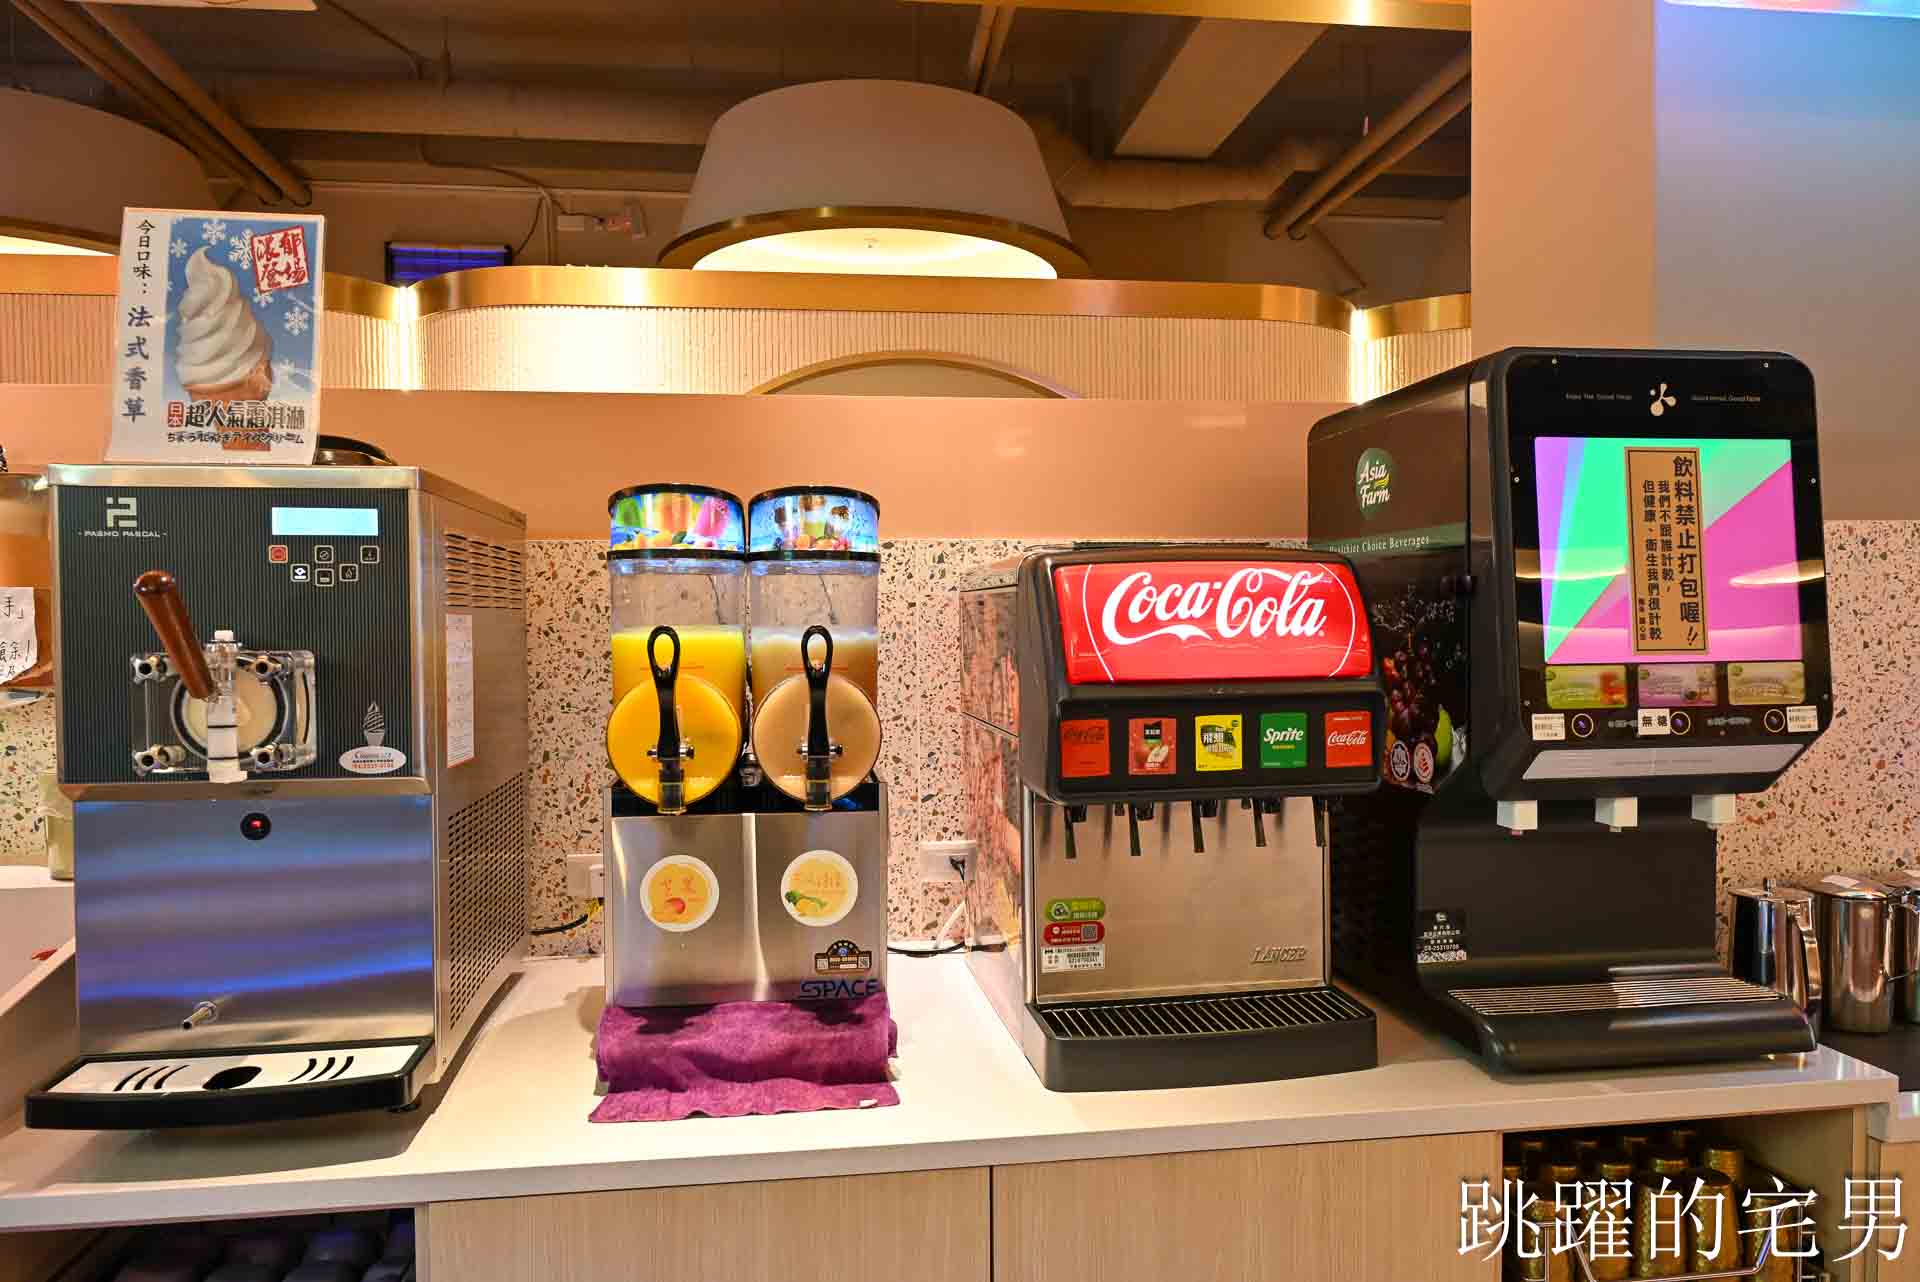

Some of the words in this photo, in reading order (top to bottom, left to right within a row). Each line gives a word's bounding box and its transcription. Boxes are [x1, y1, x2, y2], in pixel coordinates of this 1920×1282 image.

[122, 304, 153, 423] 法式香草
[185, 400, 304, 429] 超人氣霜淇淋
[1358, 460, 1387, 484] Asia
[1360, 485, 1390, 508] Farm
[1389, 536, 1430, 550] Beverages
[1102, 567, 1331, 645] Coca-Cola
[1264, 727, 1304, 744] Sprite
[1328, 730, 1368, 746] Coca-Cola
[798, 979, 879, 998] SPACE
